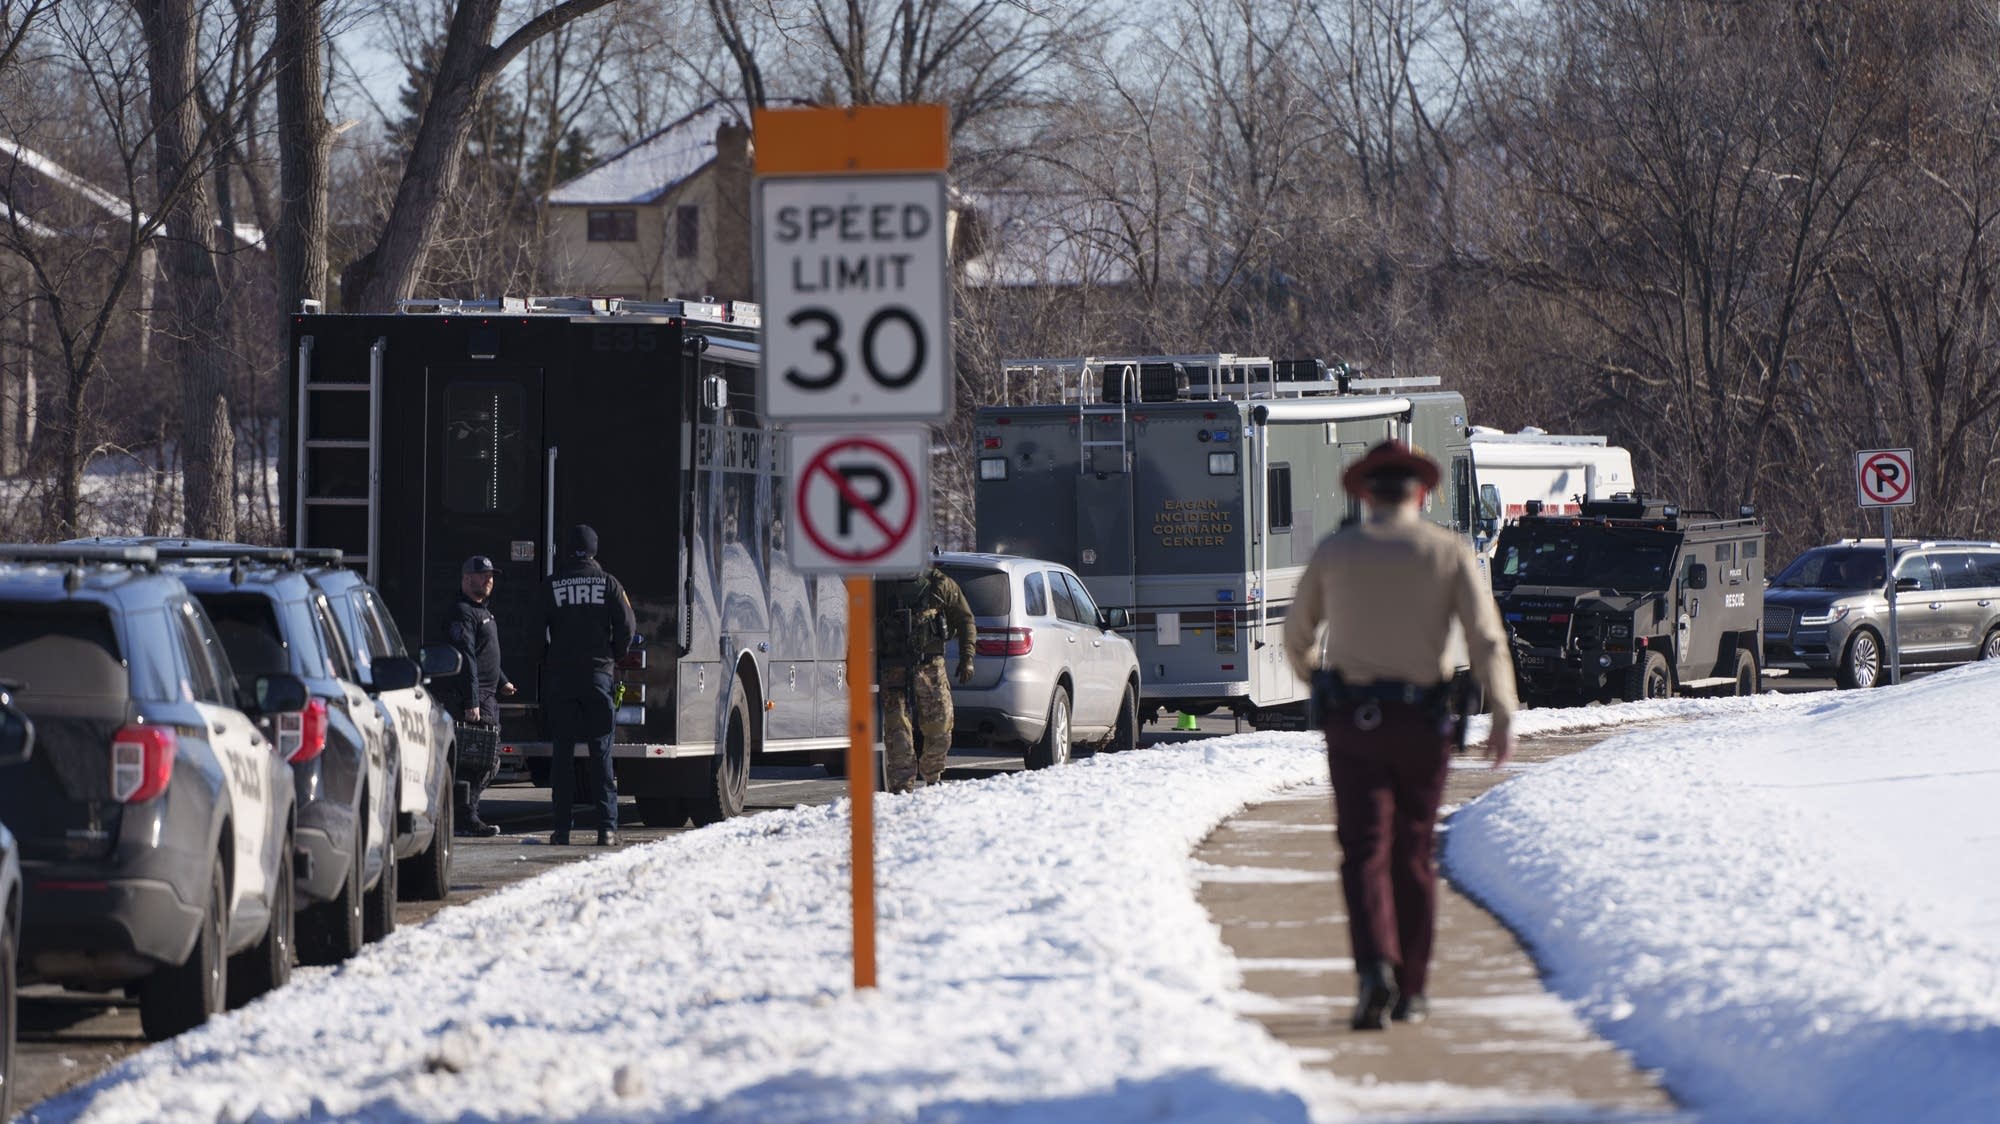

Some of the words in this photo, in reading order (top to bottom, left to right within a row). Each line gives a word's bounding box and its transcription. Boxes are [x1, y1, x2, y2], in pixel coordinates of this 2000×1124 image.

[775, 204, 931, 243] SPEED
[791, 254, 913, 293] LIMIT
[592, 327, 656, 352] E35
[783, 305, 928, 391] 30
[699, 428, 736, 467] EAN
[1165, 499, 1217, 511] EAGAN
[1155, 511, 1230, 522] INCIDENT
[1152, 523, 1232, 535] COMMAND
[1162, 535, 1225, 547] CENTER
[1729, 568, 1742, 577] POLICE
[552, 576, 606, 589] BLOOMINGTON
[553, 584, 606, 608] FIRE
[1725, 592, 1745, 609] RESCUE
